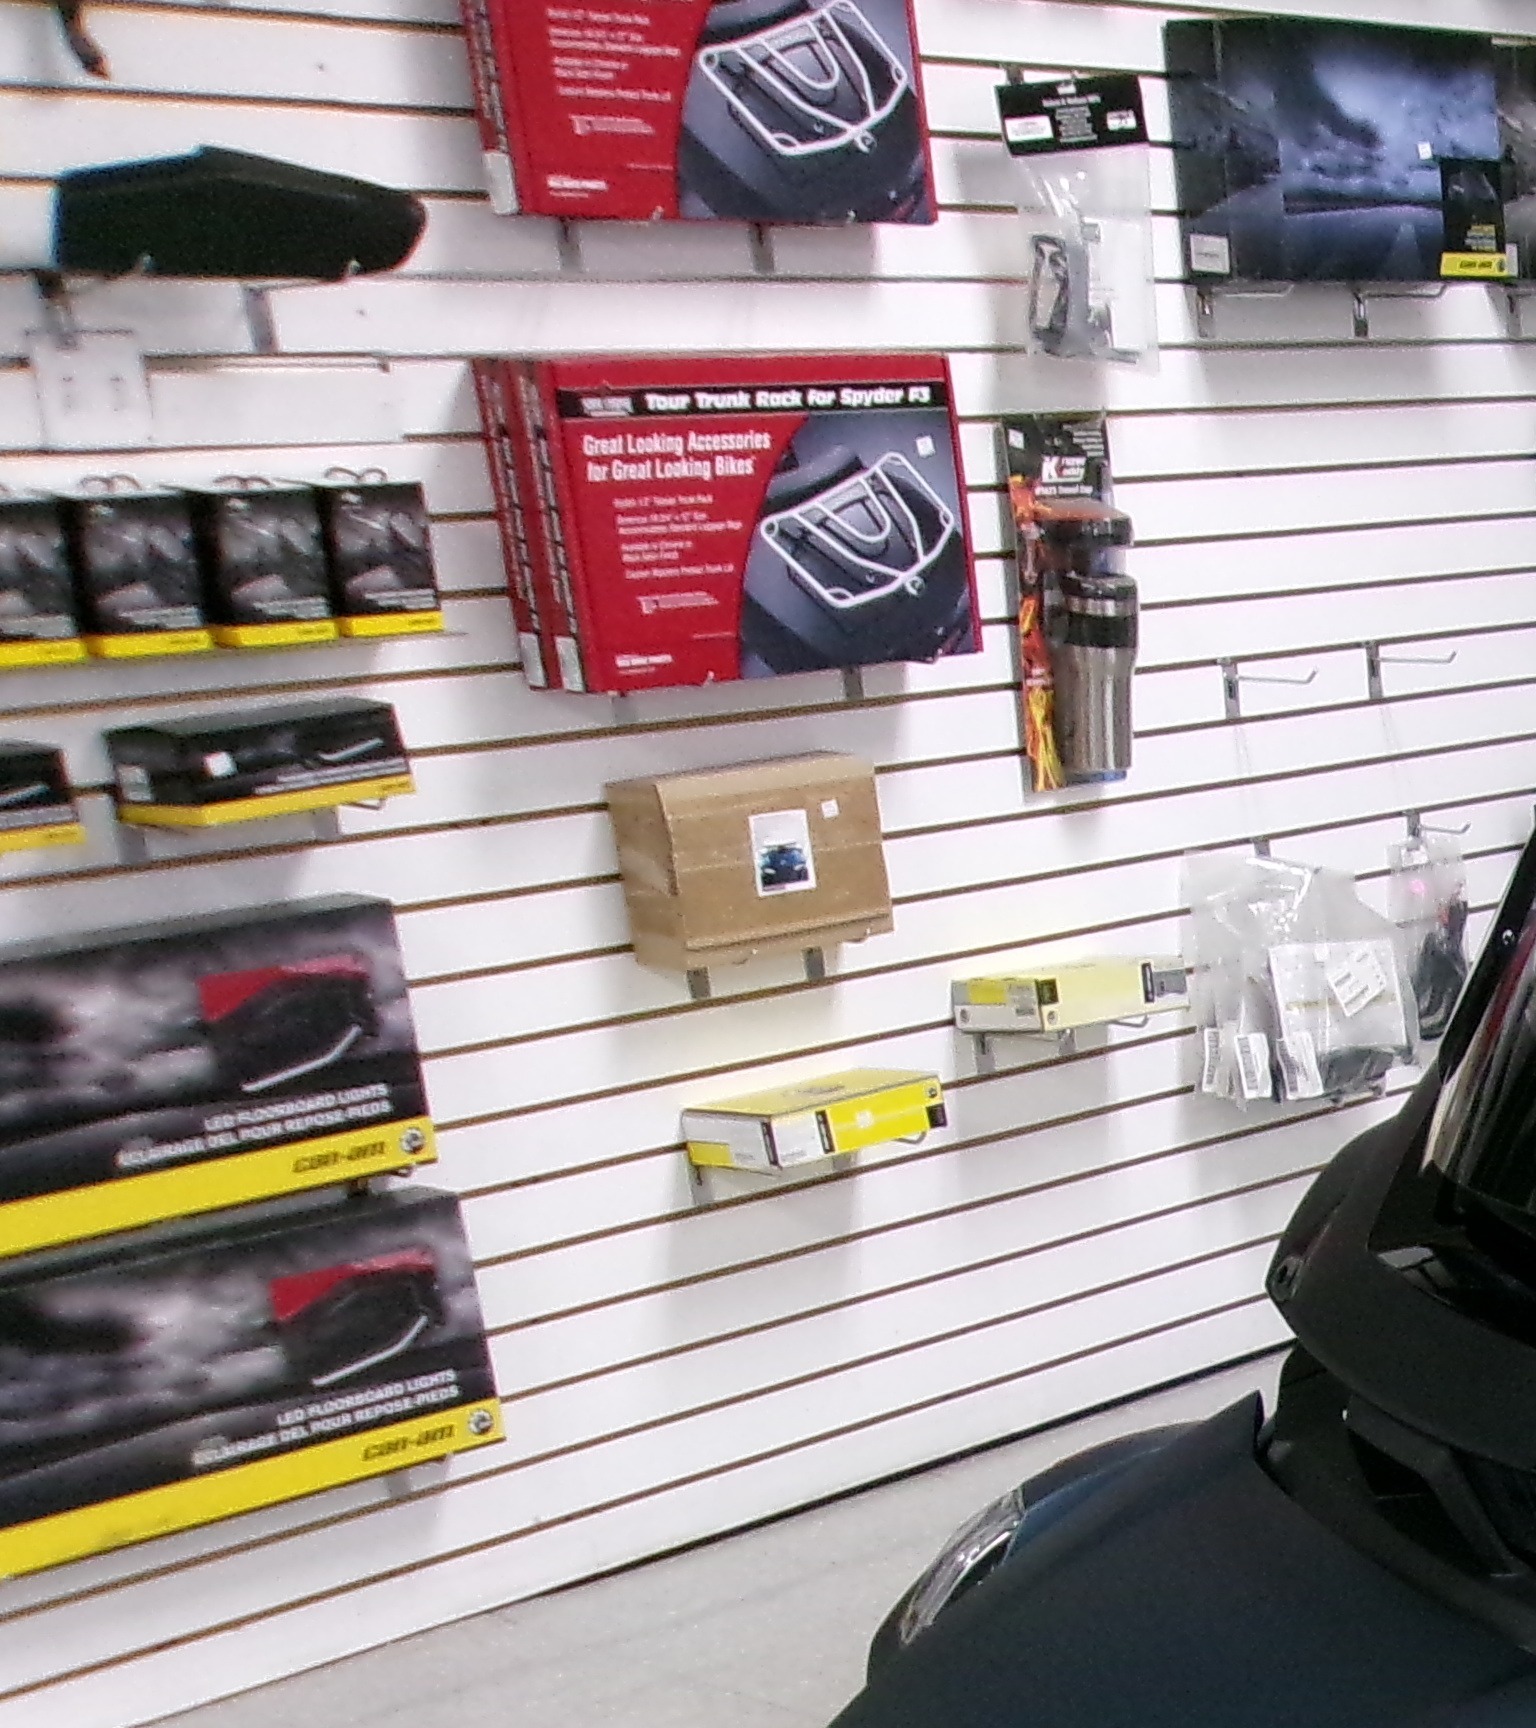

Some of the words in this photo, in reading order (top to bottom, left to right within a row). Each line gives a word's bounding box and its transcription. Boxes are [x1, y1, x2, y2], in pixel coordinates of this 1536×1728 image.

[645, 393, 691, 411] Tour
[694, 390, 751, 409] Trunk
[755, 389, 803, 408] Rack
[807, 388, 836, 406] for
[840, 386, 903, 407] Spyder
[583, 434, 623, 456] Great
[627, 432, 684, 457] Looking
[687, 429, 771, 452] Accessories
[587, 461, 609, 482] for
[612, 459, 651, 480] Great
[655, 457, 712, 481] Looking
[406, 1369, 457, 1394] LIGHTS
